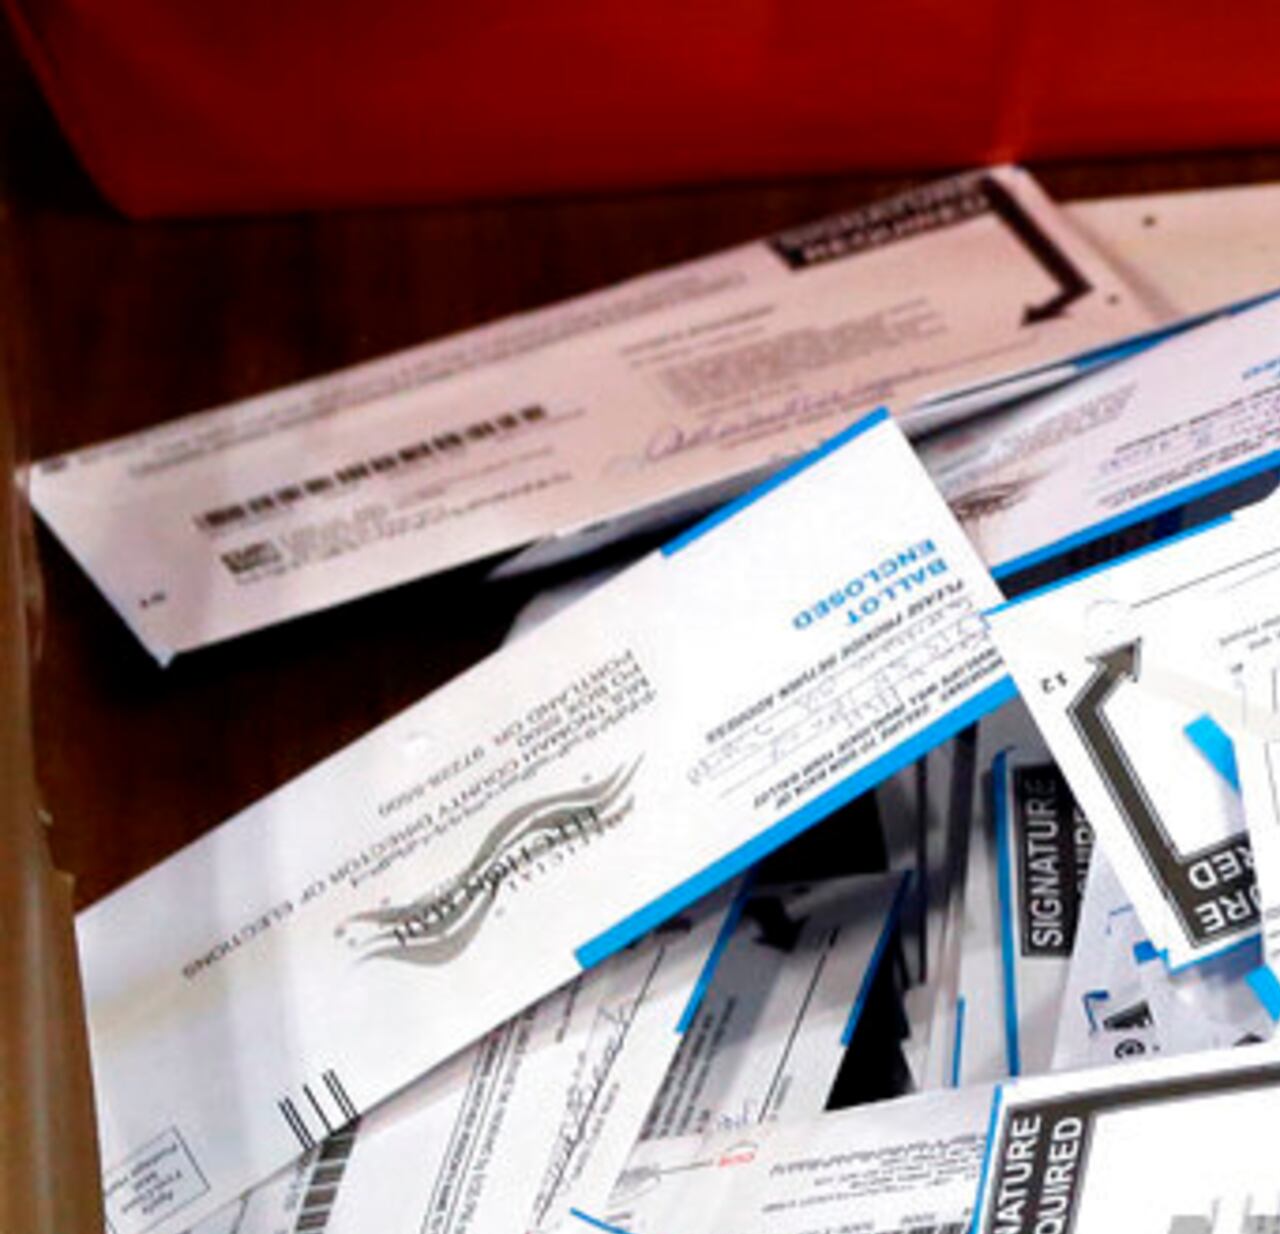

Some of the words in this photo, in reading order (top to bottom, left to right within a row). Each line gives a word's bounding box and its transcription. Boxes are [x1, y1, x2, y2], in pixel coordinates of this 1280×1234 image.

[789, 535, 937, 632] ENCLOSED
[843, 555, 949, 627] BALLOT
[905, 577, 965, 619] PLEASE
[838, 612, 905, 660] PROVIDE
[524, 649, 635, 726] PORTLAND
[558, 682, 610, 720] BOX
[611, 662, 642, 688] PO
[777, 653, 840, 699] RETURN
[491, 719, 523, 746] OR
[520, 674, 651, 766] MULTNOMAH
[703, 693, 778, 745] ADDRESS
[436, 757, 521, 819] COUNTY
[328, 811, 434, 886] DIRECTOR
[1025, 773, 1059, 947] SIGNATURE
[297, 878, 328, 904] OF
[179, 900, 295, 981] ELECTIONS
